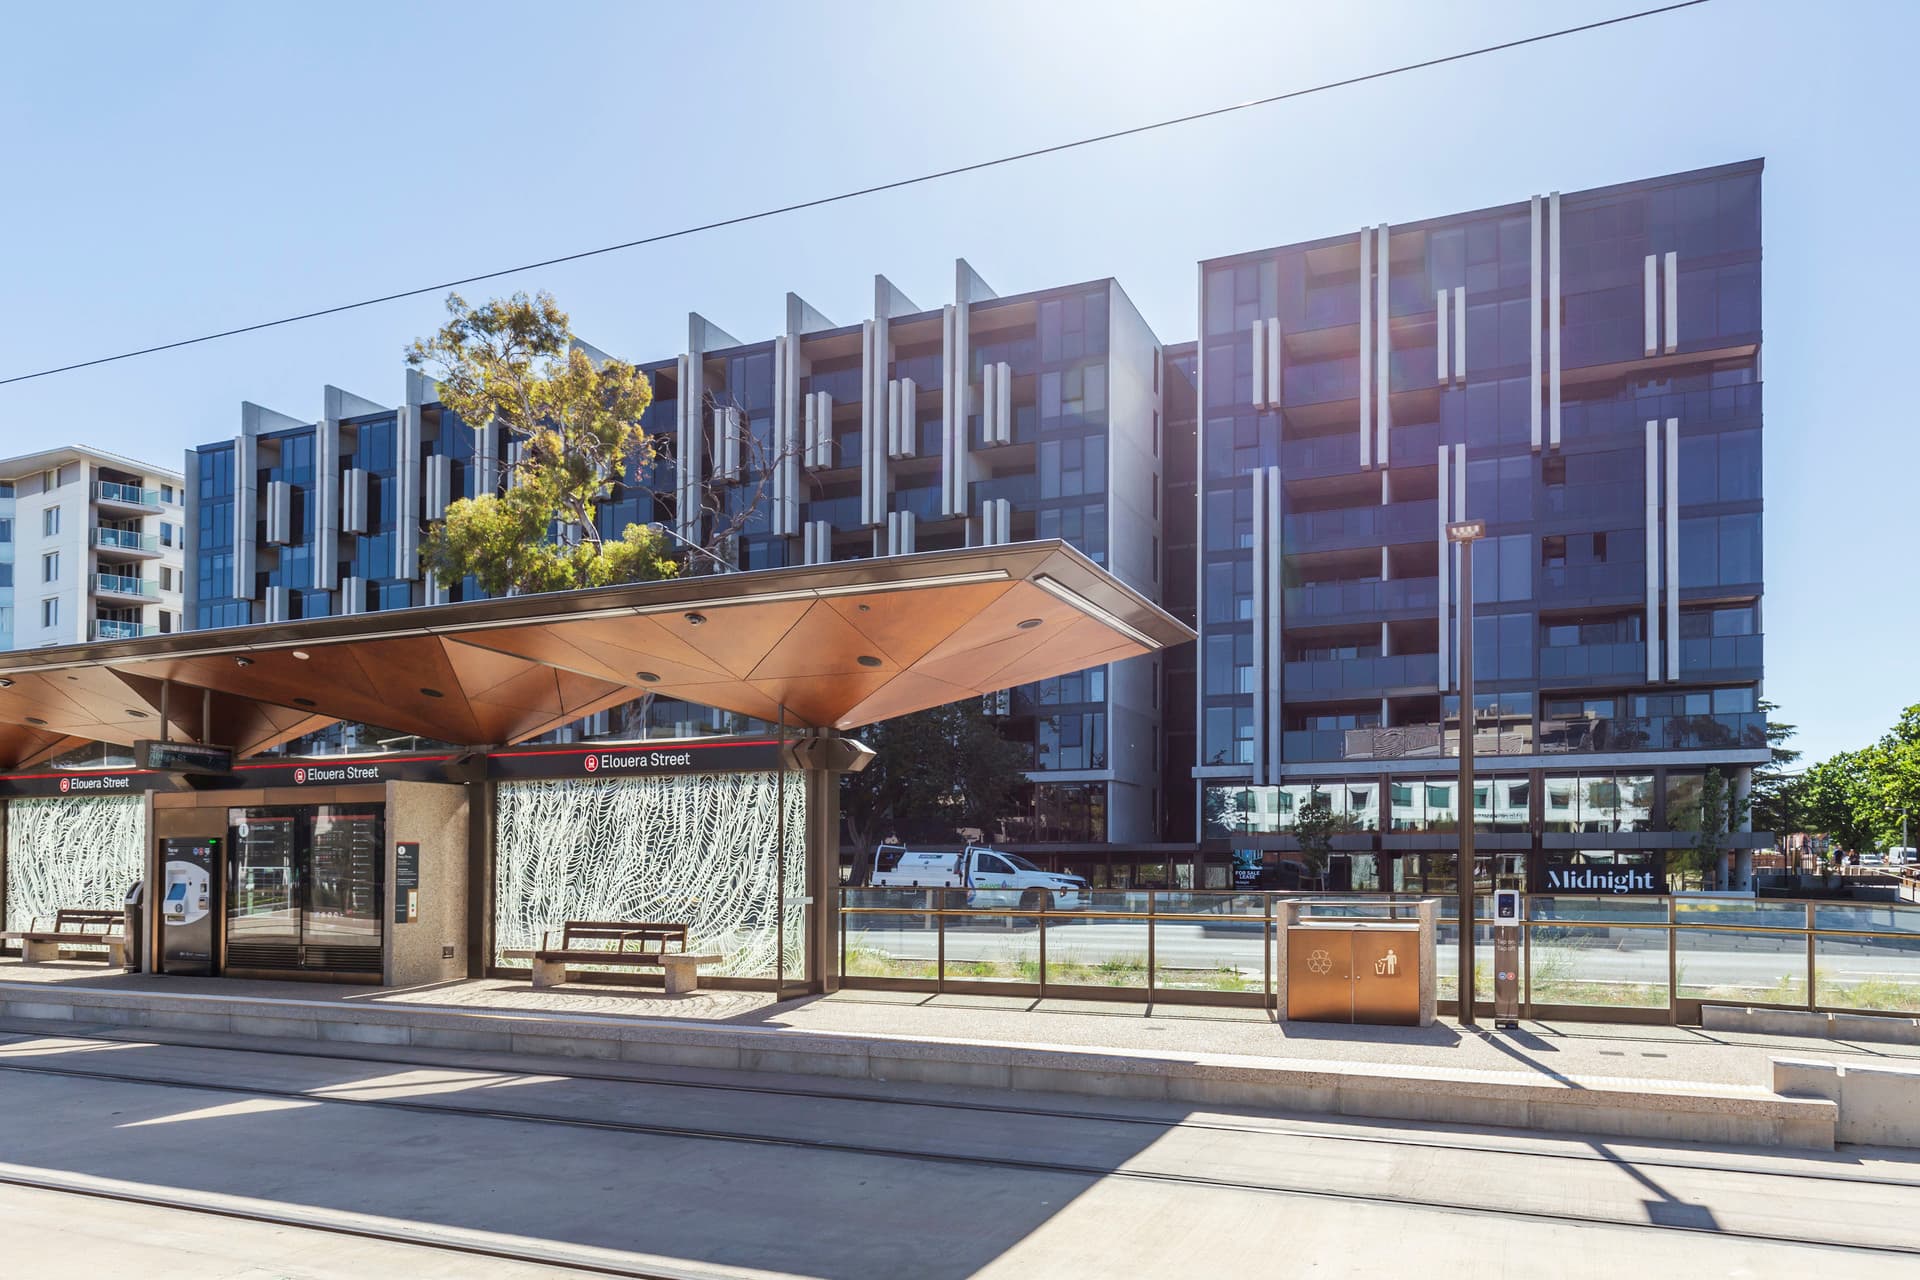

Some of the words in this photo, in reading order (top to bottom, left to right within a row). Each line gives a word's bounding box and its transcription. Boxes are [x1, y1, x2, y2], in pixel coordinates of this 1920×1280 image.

[601, 754, 648, 768] Elouera
[650, 752, 691, 766] Street
[307, 767, 345, 780] Elouera
[347, 766, 379, 779] Street
[71, 778, 102, 789] Elouera
[103, 777, 130, 788] Street
[1547, 869, 1655, 894] Midnight
